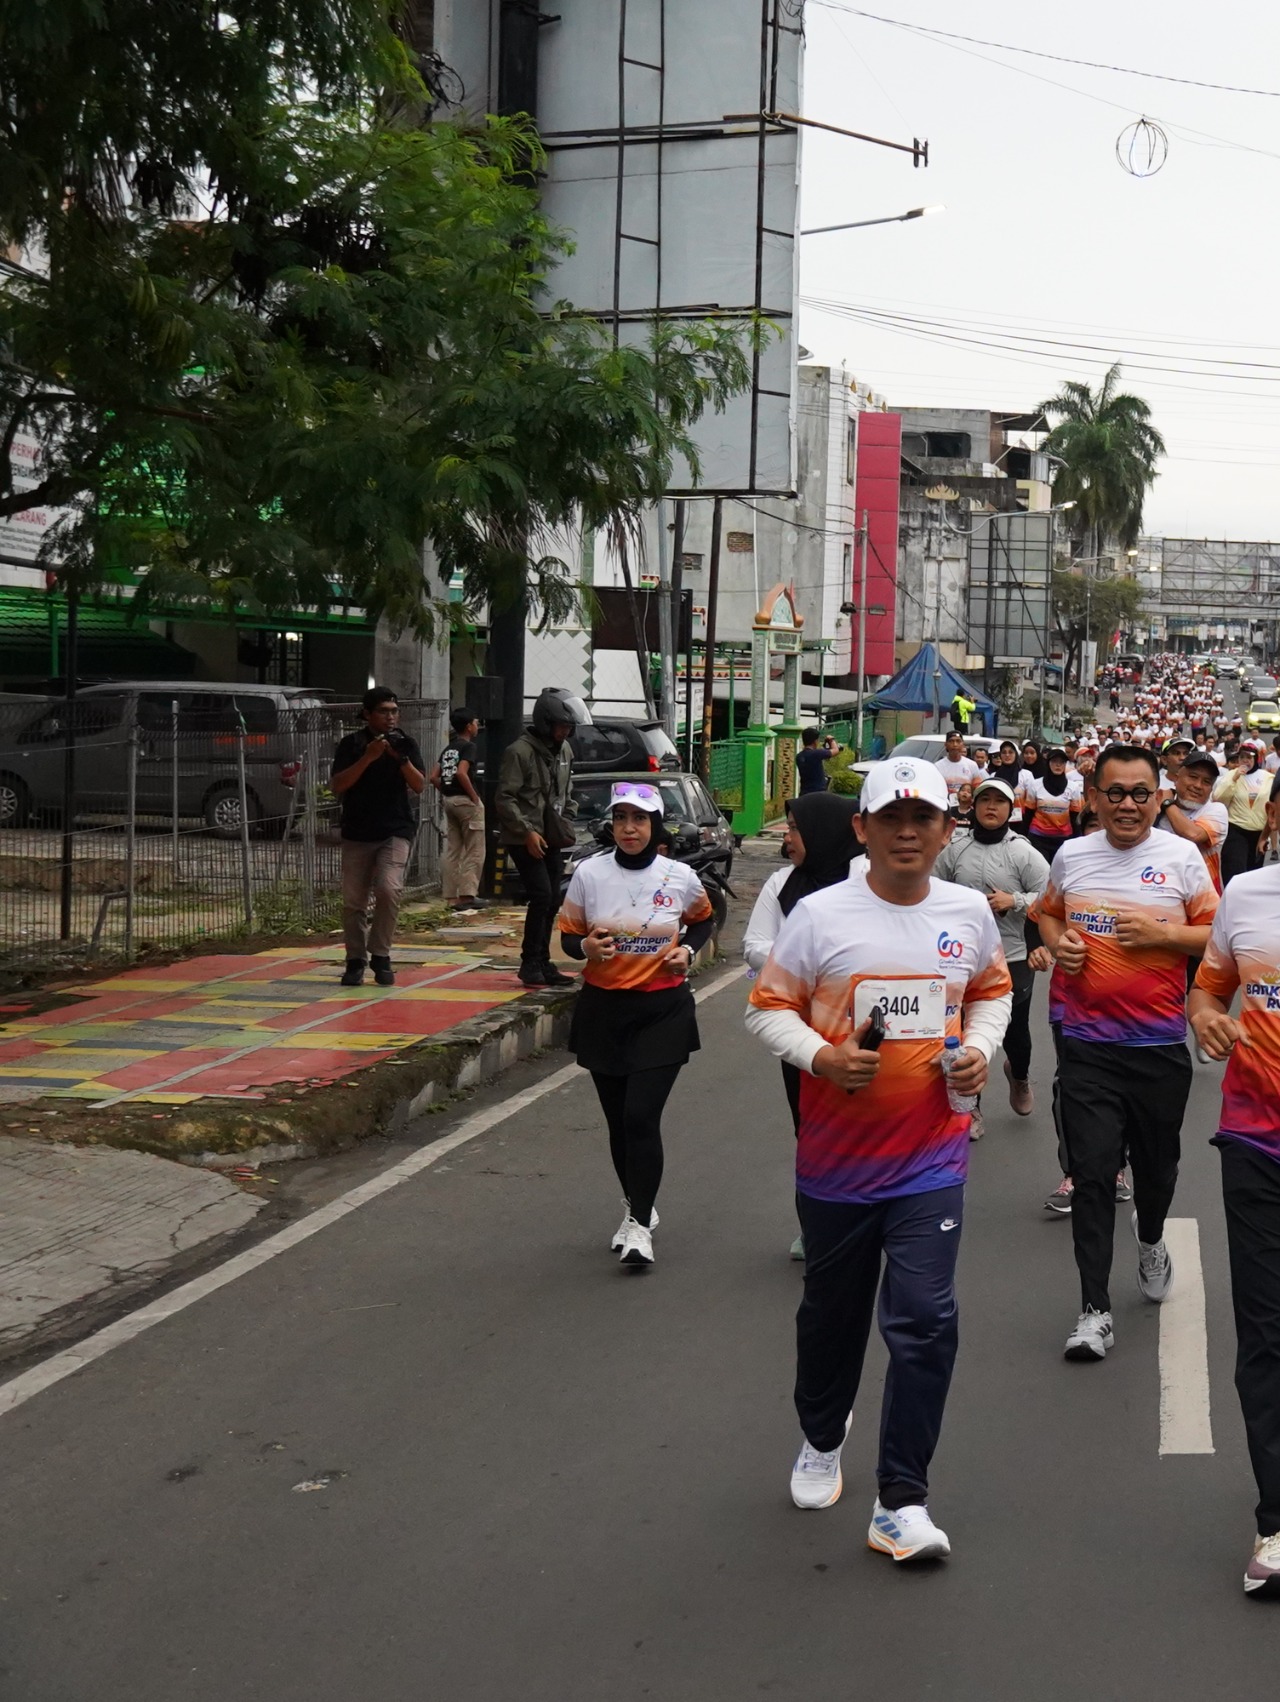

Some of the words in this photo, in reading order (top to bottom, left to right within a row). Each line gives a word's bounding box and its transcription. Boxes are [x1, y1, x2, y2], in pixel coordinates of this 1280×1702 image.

[1070, 911, 1100, 923] BANK
[1087, 923, 1112, 934] RUN
[633, 945, 658, 953] 2026
[1246, 983, 1280, 996] BANK
[879, 996, 920, 1016] 3404
